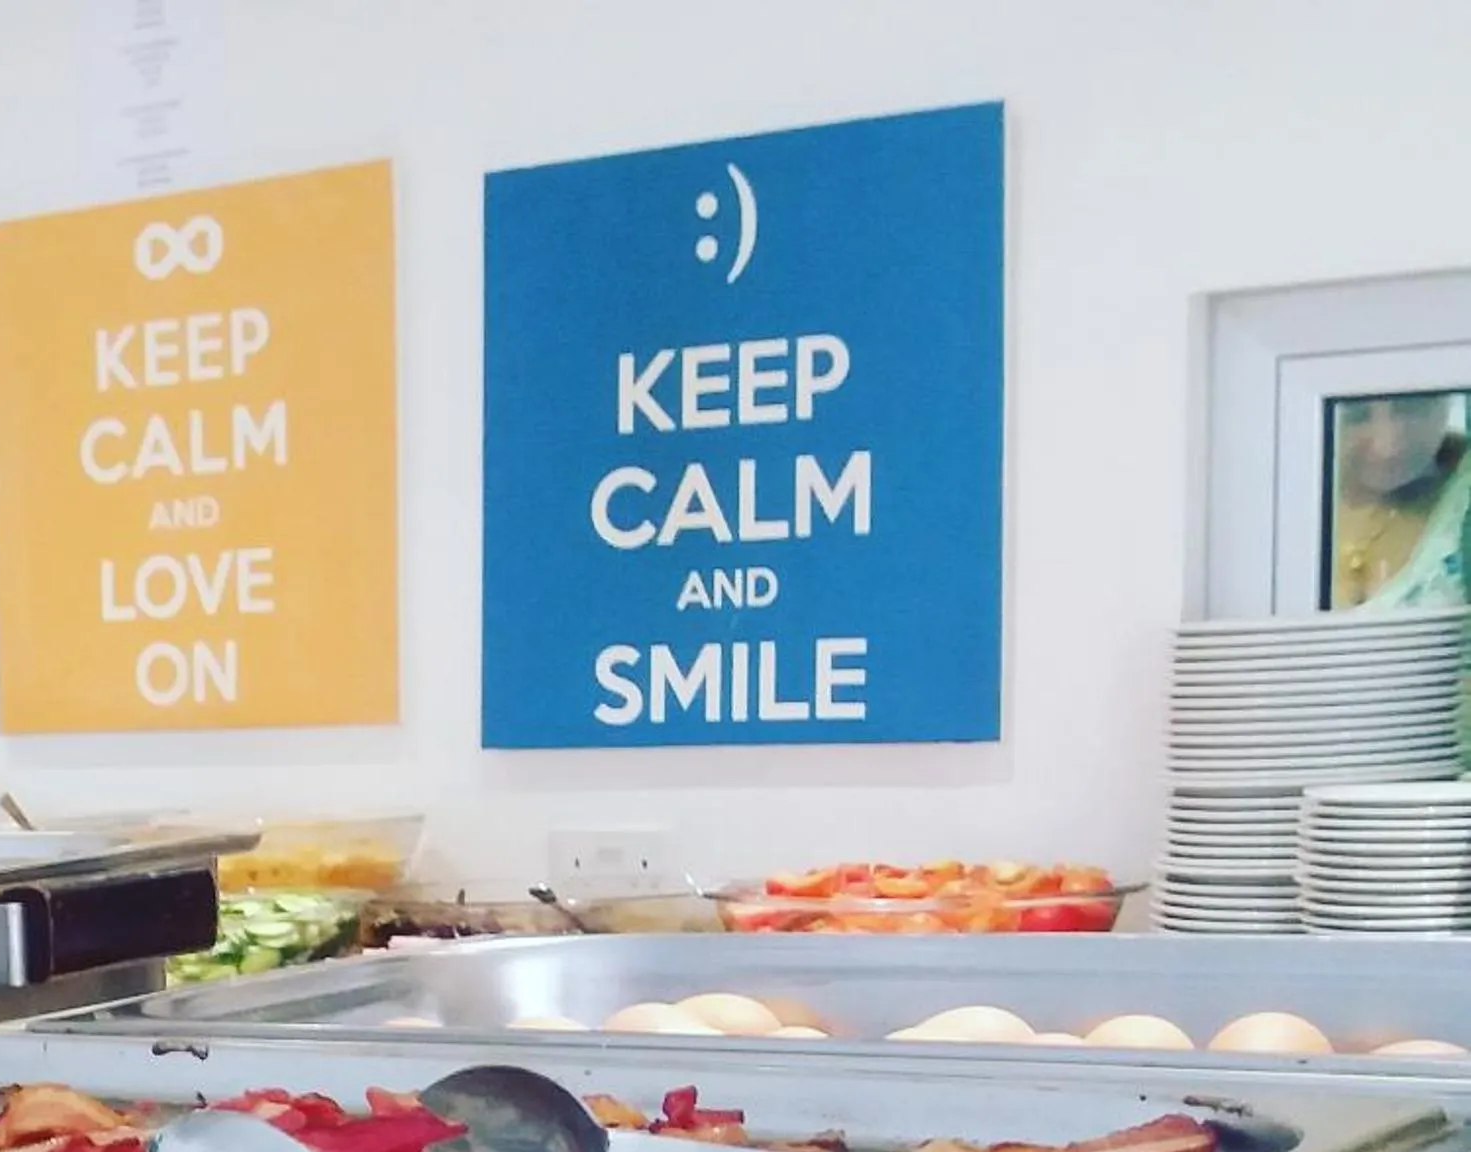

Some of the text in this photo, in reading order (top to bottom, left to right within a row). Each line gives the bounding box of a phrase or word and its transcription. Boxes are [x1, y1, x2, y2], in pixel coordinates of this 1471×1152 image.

[95, 307, 270, 391] KEEP
[618, 334, 850, 434] KEEP
[80, 400, 287, 483] CALM
[149, 496, 220, 529] AND
[591, 450, 872, 549] CALM
[100, 547, 275, 621] LOVE
[676, 567, 779, 611] AND
[135, 639, 238, 707] ON
[594, 637, 869, 726] SMILE
